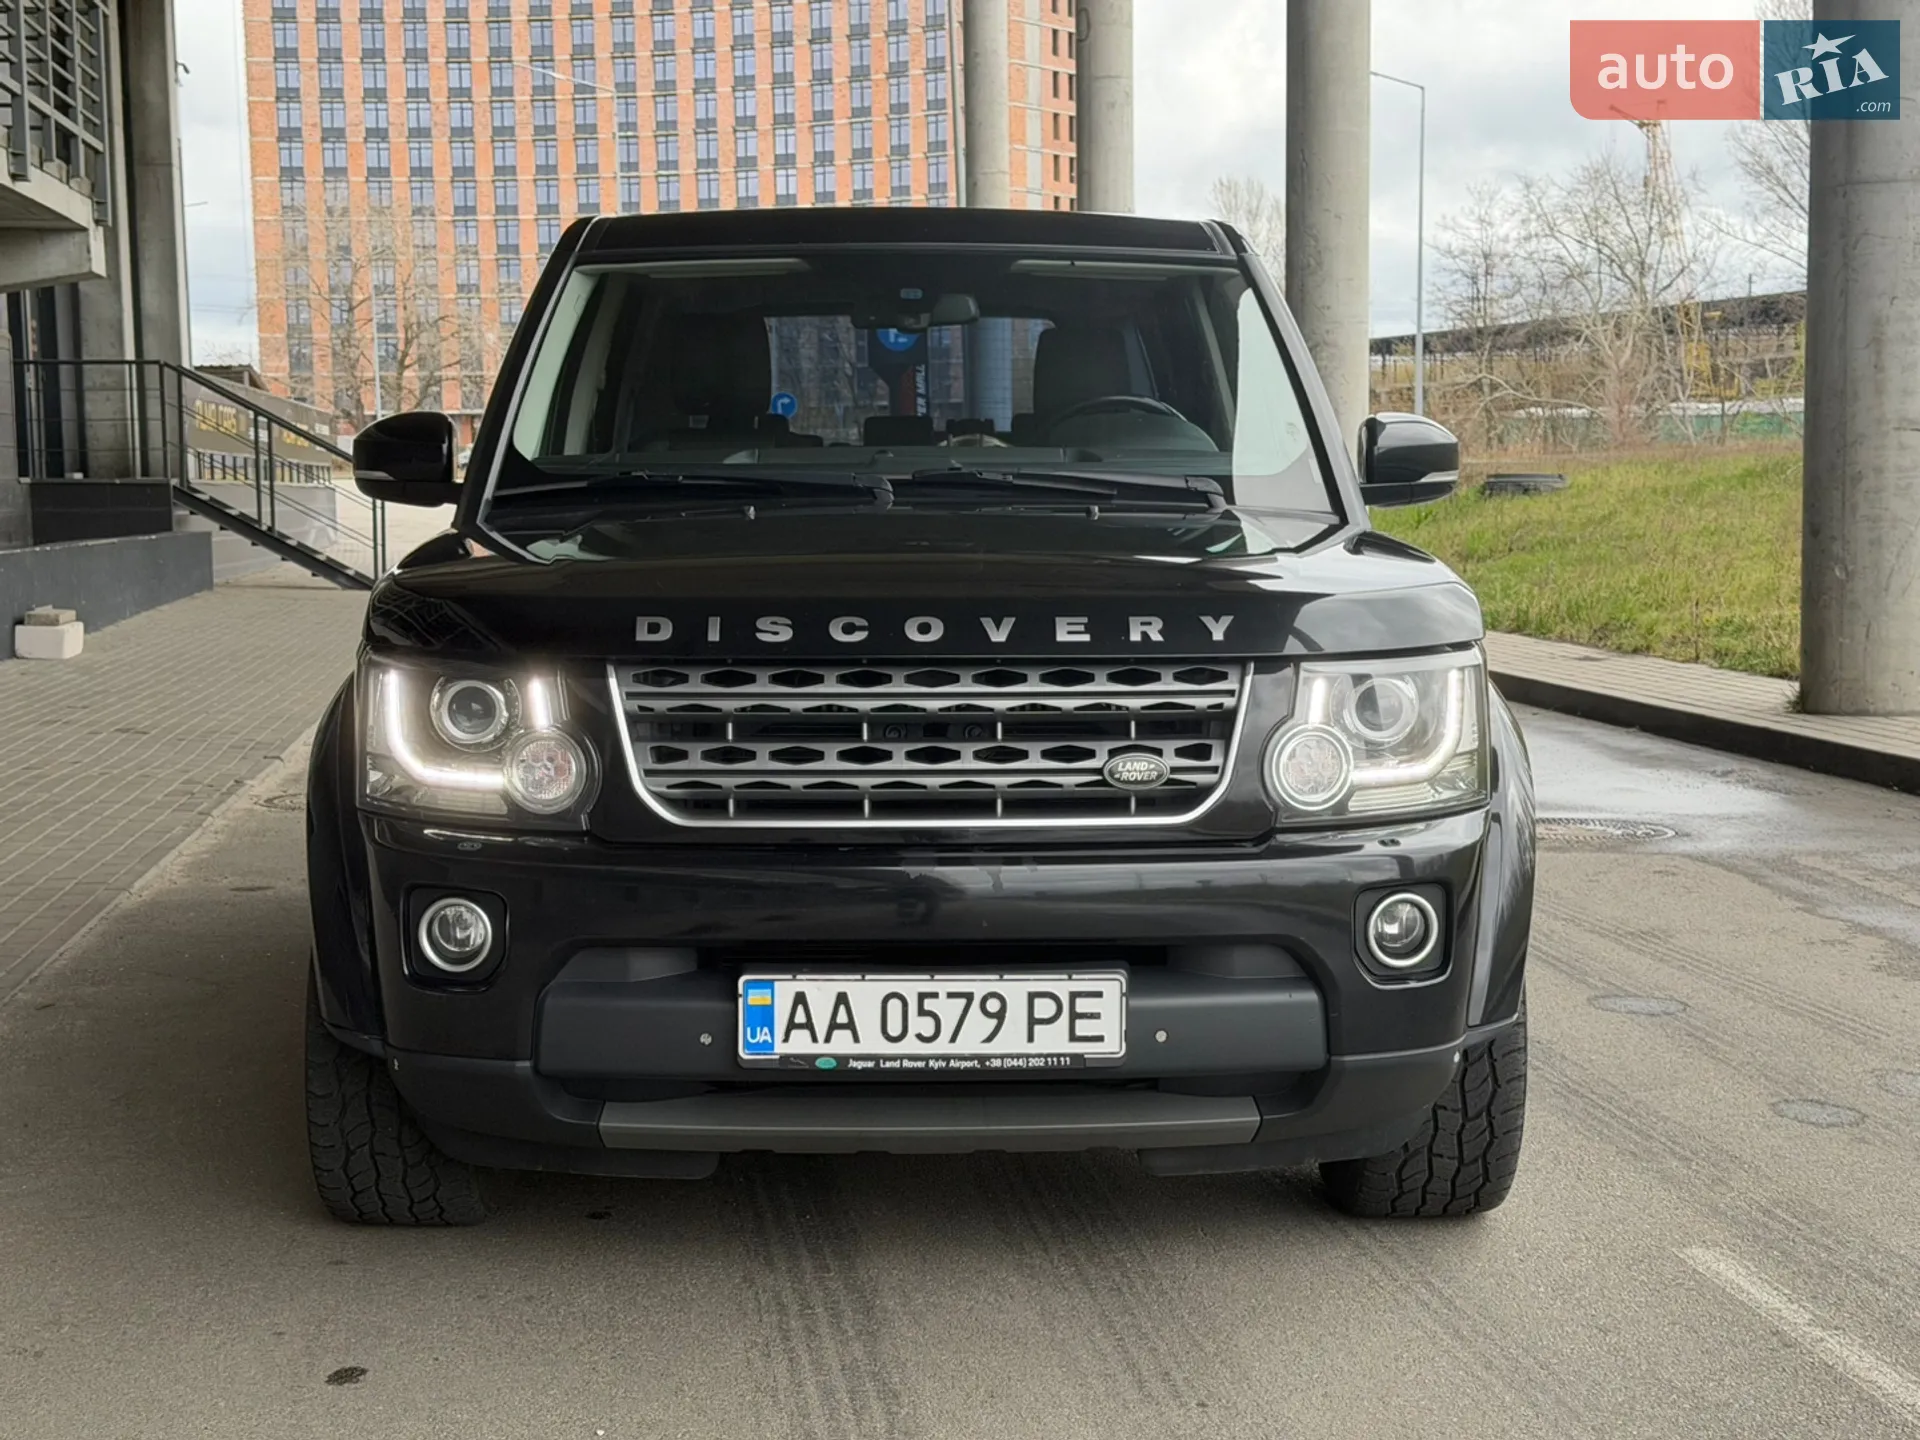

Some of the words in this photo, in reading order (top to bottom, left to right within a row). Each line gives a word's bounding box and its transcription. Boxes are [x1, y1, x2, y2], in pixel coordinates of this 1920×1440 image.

[635, 615, 1234, 642] DISCOVERY
[1118, 761, 1148, 771] LAND
[1121, 771, 1158, 781] ROVER
[781, 991, 861, 1044] AA
[880, 991, 1008, 1044] 0579
[1026, 990, 1105, 1043] PE
[747, 1027, 772, 1043] UA
[848, 1058, 875, 1070] Jaguar
[880, 1058, 900, 1068] Land
[902, 1058, 926, 1068] Rover
[928, 1058, 947, 1070] Kyiv
[949, 1058, 980, 1070] Airport,
[985, 1058, 1001, 1068] +38
[1003, 1057, 1027, 1068] (044)
[1028, 1057, 1045, 1067] 202
